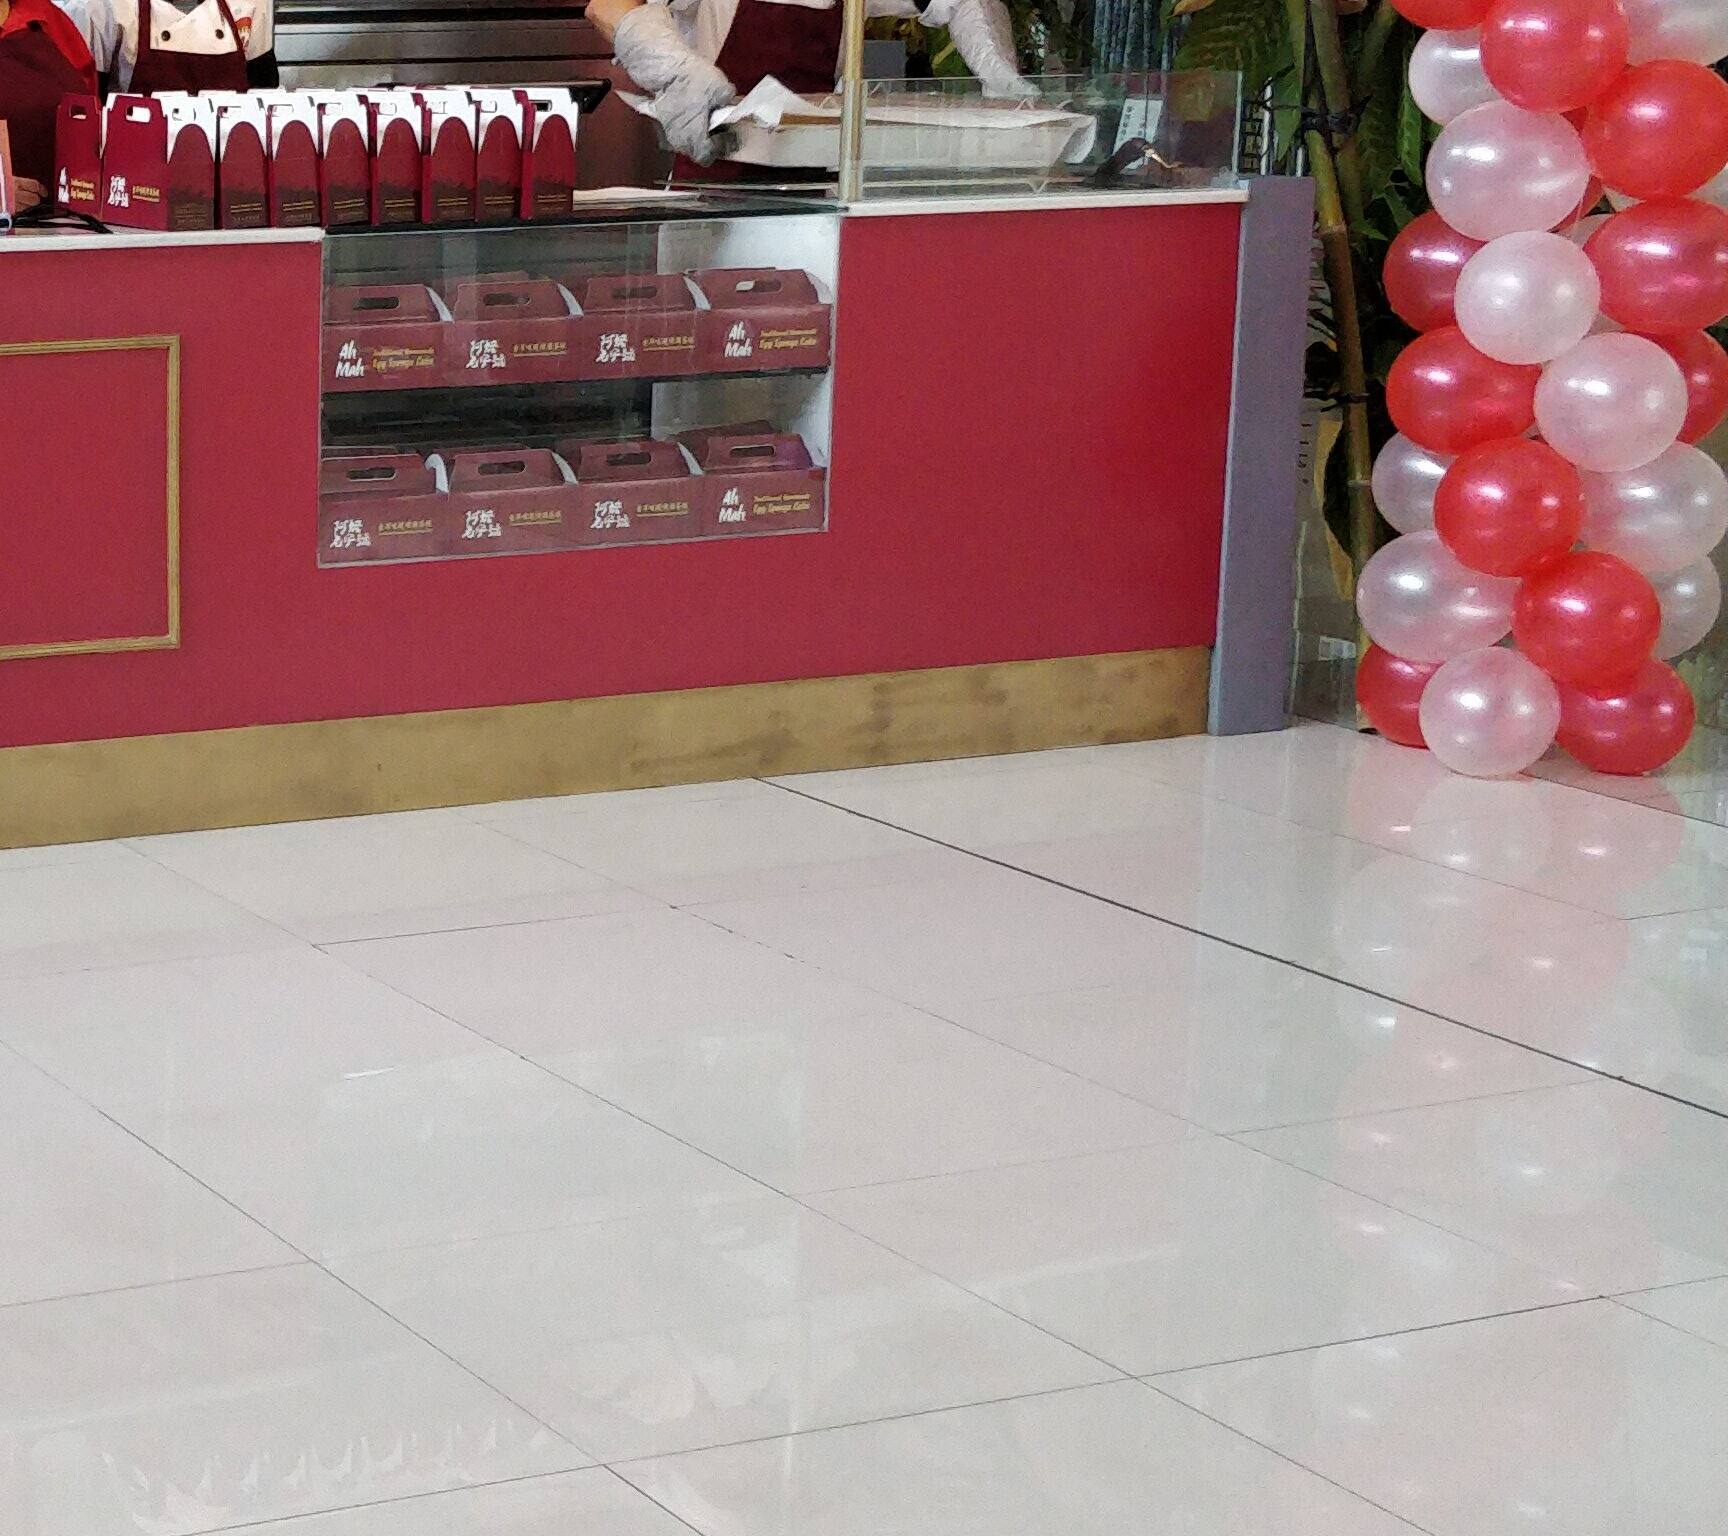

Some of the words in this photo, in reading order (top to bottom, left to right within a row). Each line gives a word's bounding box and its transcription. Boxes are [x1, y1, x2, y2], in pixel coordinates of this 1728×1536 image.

[728, 321, 746, 340] Ah
[339, 340, 357, 359] Ah
[724, 339, 753, 358] Mah
[335, 360, 365, 378] Mah
[723, 487, 739, 506] Ah
[718, 505, 747, 523] Mah
